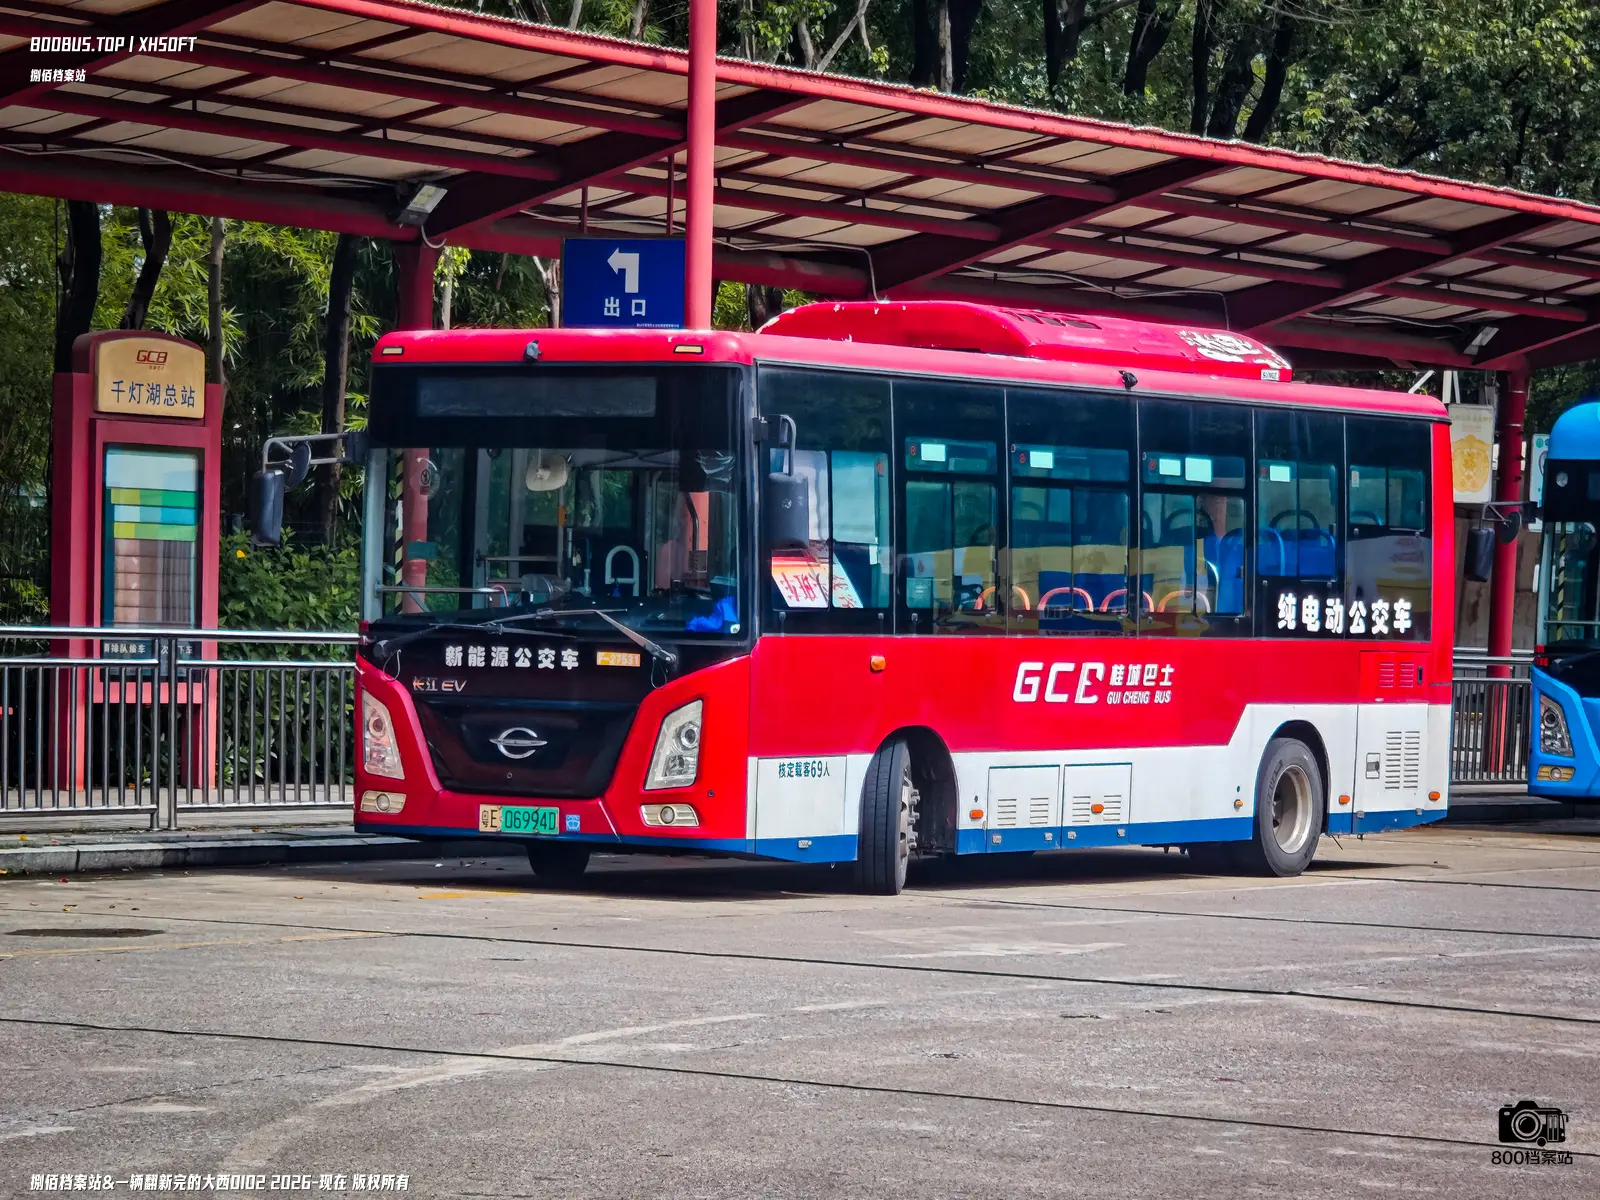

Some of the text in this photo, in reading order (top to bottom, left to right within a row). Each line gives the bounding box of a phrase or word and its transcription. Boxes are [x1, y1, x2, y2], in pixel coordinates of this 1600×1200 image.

[604, 296, 646, 318] 出口
[136, 350, 168, 363] GCB
[111, 380, 196, 408] 千灯湖总站
[1278, 592, 1412, 634] 纯电动公交车
[445, 645, 579, 670] 新能源公交车
[412, 676, 467, 692] 长江 EV
[1109, 663, 1174, 686] 桂城巴士
[1107, 690, 1172, 704] GUI CHENG BUS
[779, 760, 830, 778] 核定载客69人
[504, 810, 556, 830] 06994D
